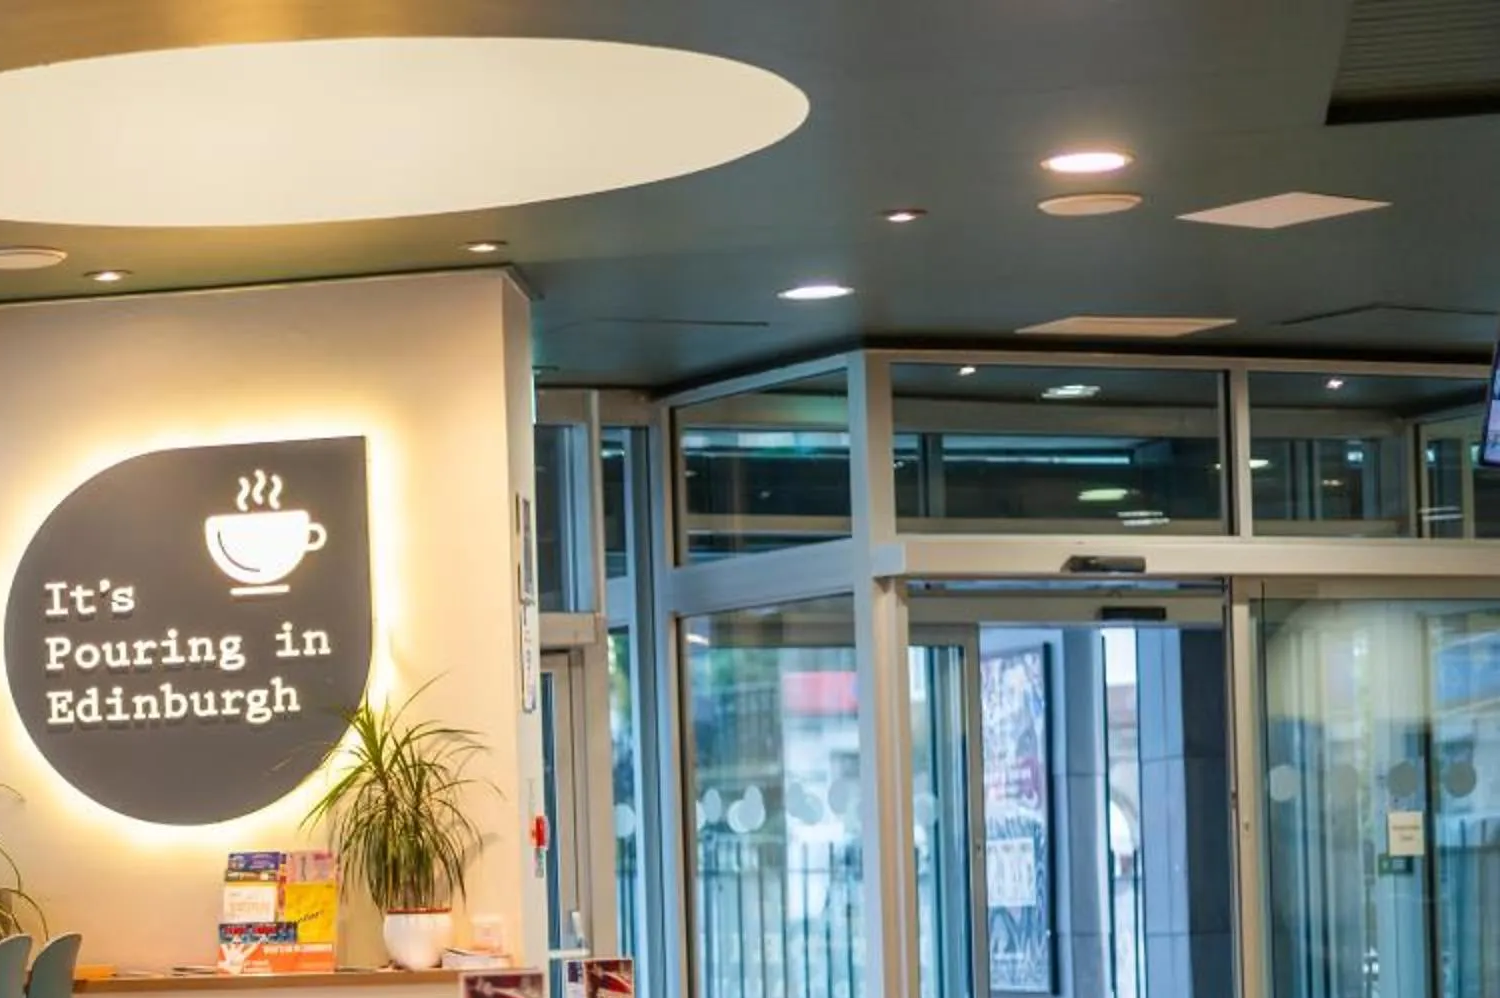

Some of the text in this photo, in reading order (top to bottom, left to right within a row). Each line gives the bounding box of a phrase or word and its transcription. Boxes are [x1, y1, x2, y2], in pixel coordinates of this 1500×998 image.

[45, 578, 135, 616] It's
[45, 621, 332, 671] Pouring in
[46, 676, 301, 724] Edinburgh
